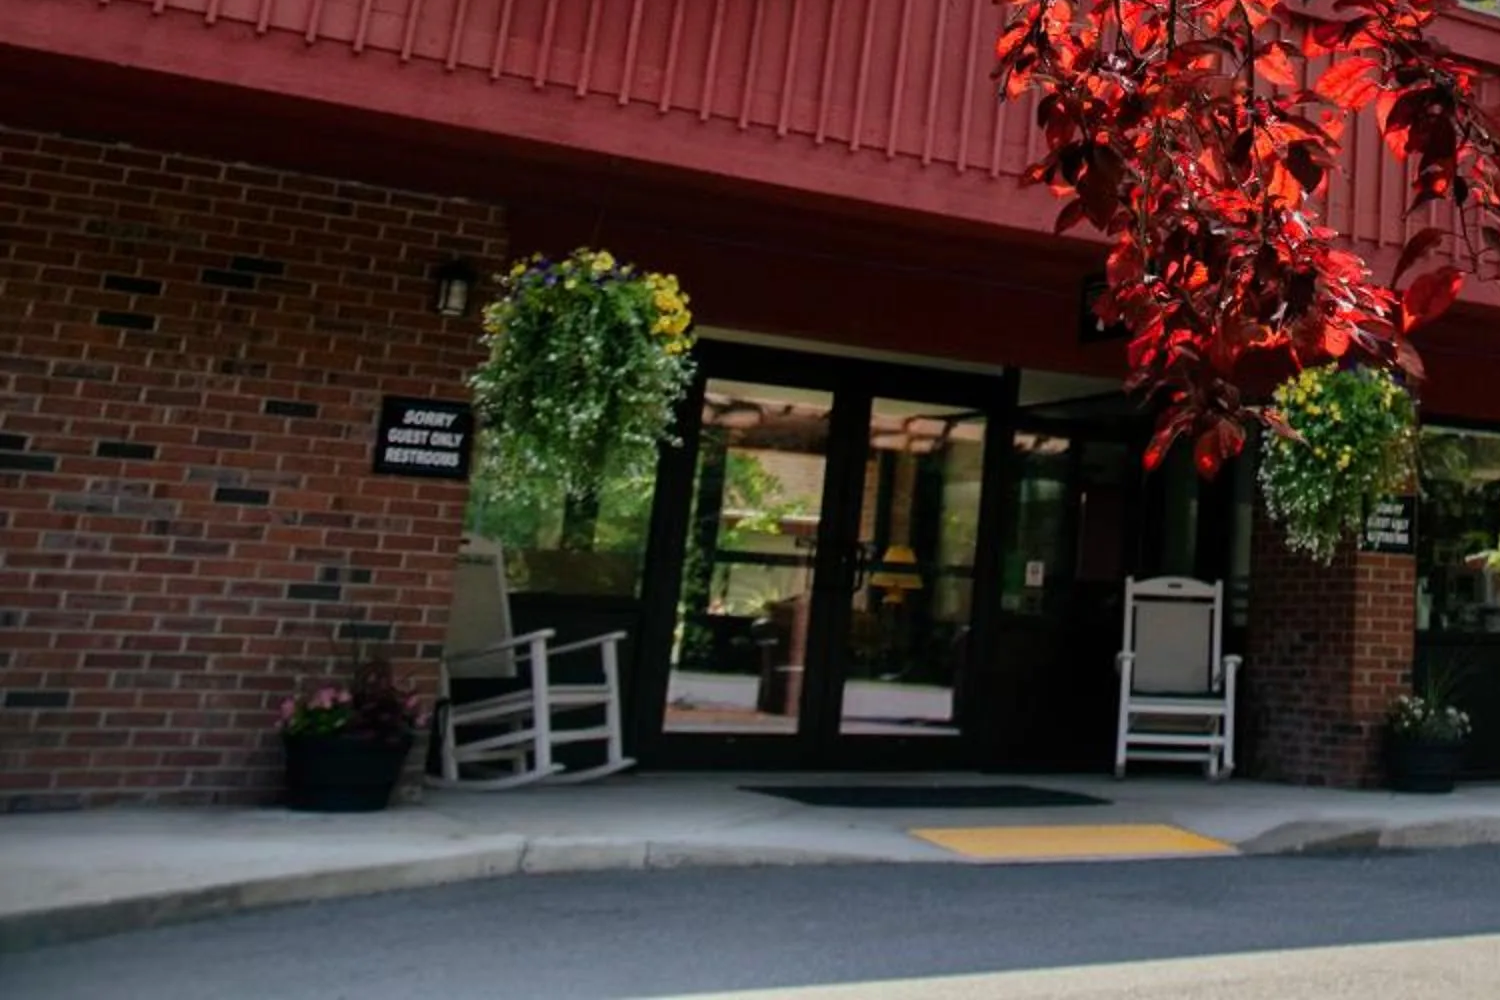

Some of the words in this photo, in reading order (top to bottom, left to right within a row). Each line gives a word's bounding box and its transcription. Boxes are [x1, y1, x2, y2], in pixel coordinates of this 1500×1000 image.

[403, 410, 457, 427] SORRY
[388, 428, 429, 444] GUEST
[430, 432, 463, 447] ONLY
